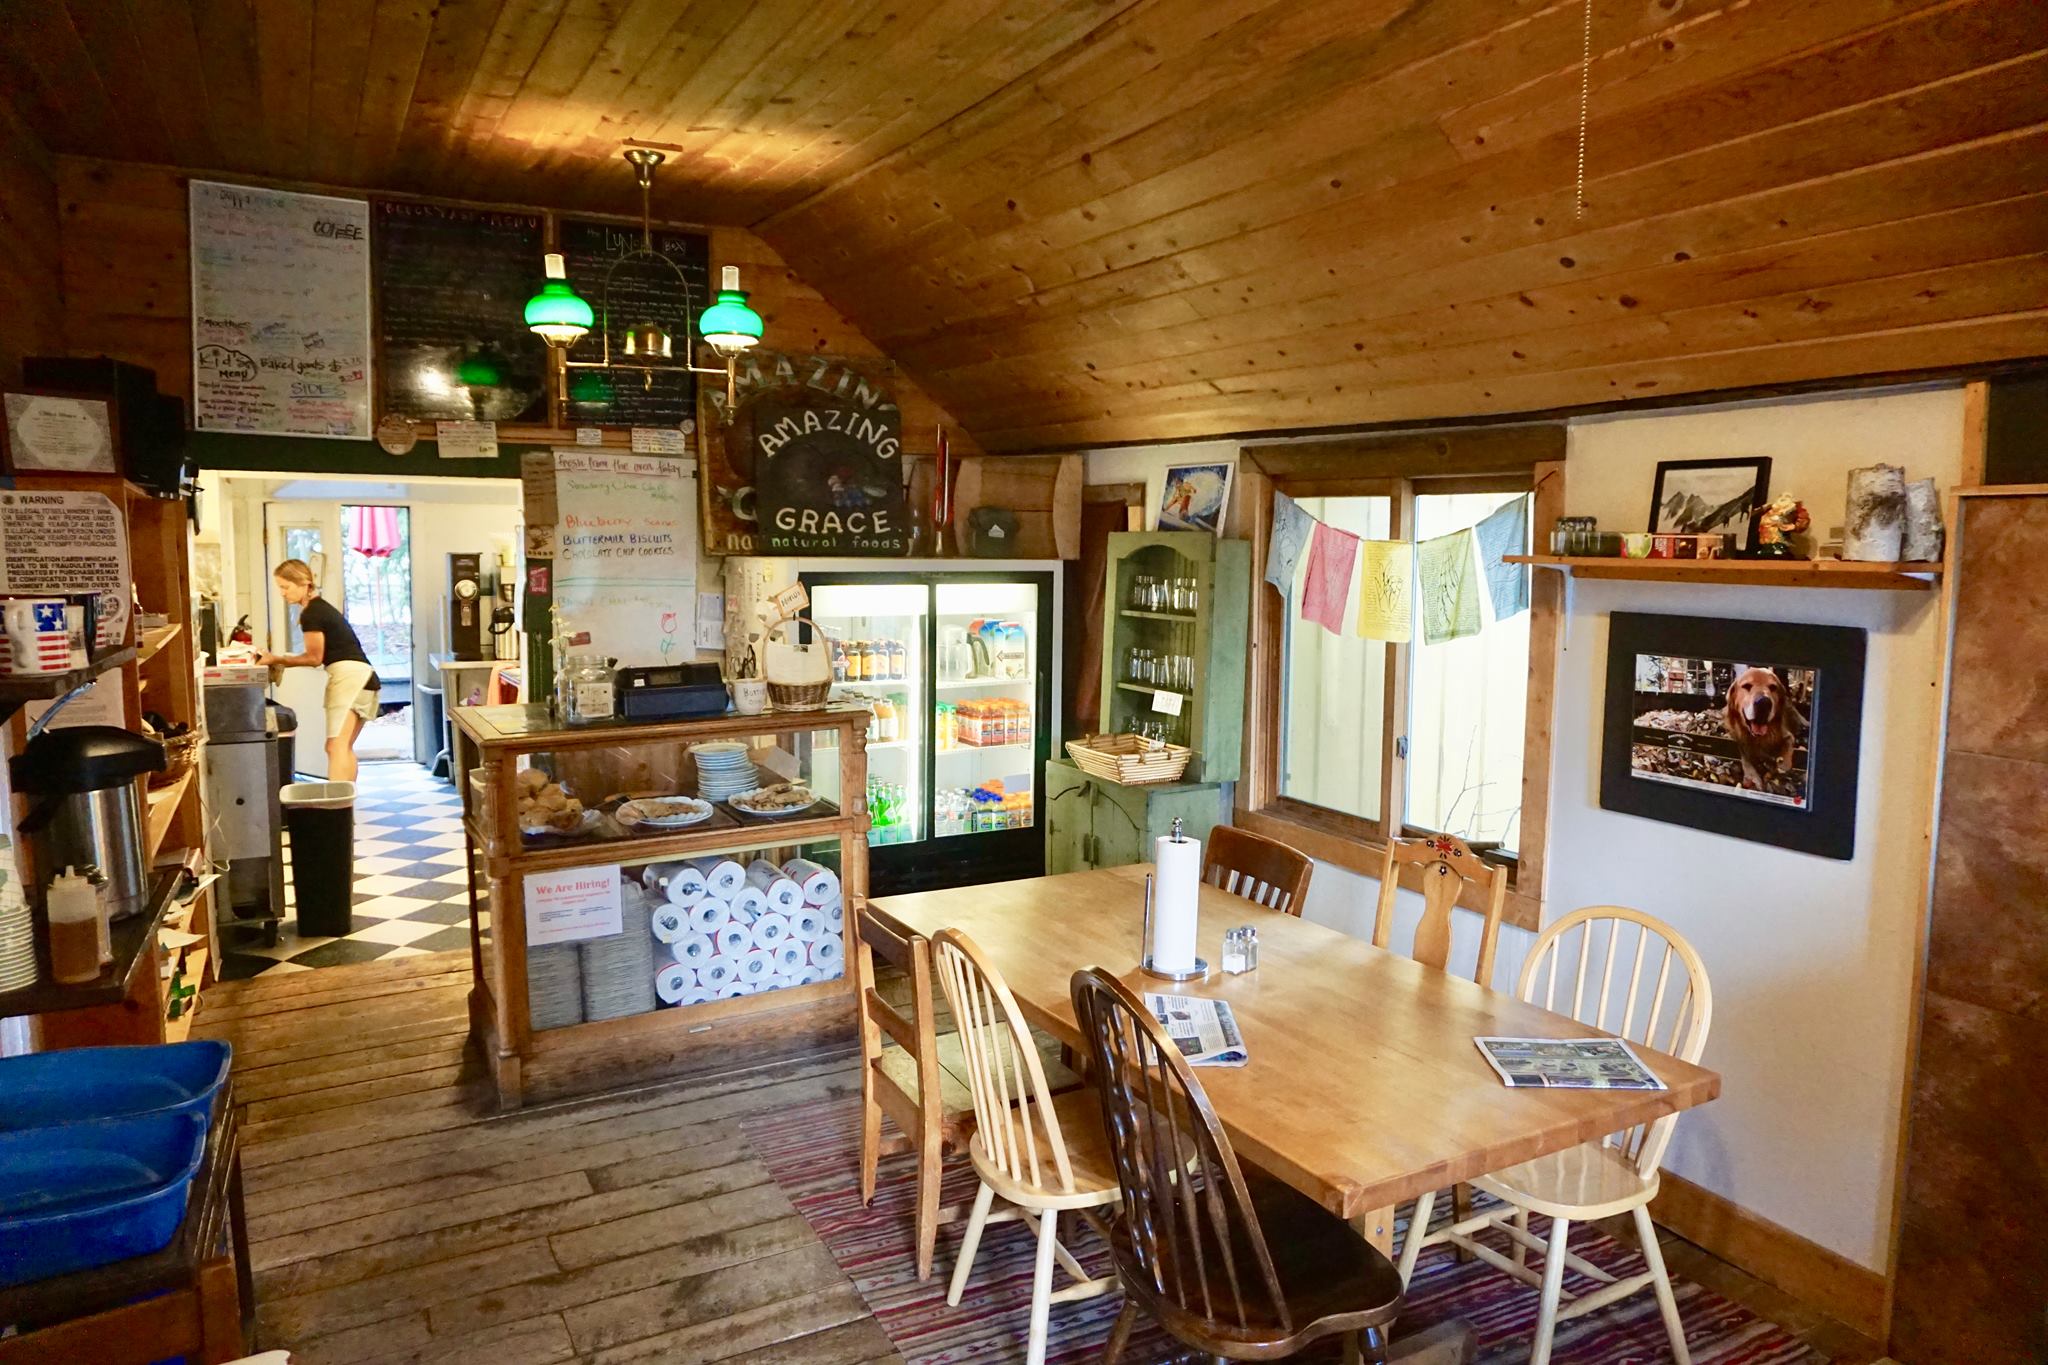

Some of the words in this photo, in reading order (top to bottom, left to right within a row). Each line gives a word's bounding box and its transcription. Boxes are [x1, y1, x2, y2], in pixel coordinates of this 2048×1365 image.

[312, 219, 364, 241] COFFEE
[490, 214, 536, 231] MENU
[260, 359, 294, 371] Baked
[291, 382, 345, 395] SIDES
[704, 355, 896, 421] AMAZIN
[758, 409, 899, 459] AMAZING
[588, 456, 609, 470] from
[613, 457, 629, 471] the
[633, 463, 655, 473] oven
[19, 496, 65, 505] WARNING
[566, 514, 632, 528] Blueberry
[775, 507, 891, 535] GRACE
[562, 534, 625, 546] BUTTERMILK
[629, 533, 673, 544] BISCUITS
[771, 536, 837, 548] natural
[852, 535, 901, 549] foods
[562, 548, 612, 560] CHOCOLATE
[616, 547, 635, 558] CHIP
[638, 546, 675, 556] COOKIES
[535, 885, 553, 895] We
[555, 883, 573, 893] Are
[575, 878, 611, 891] Hiring!
